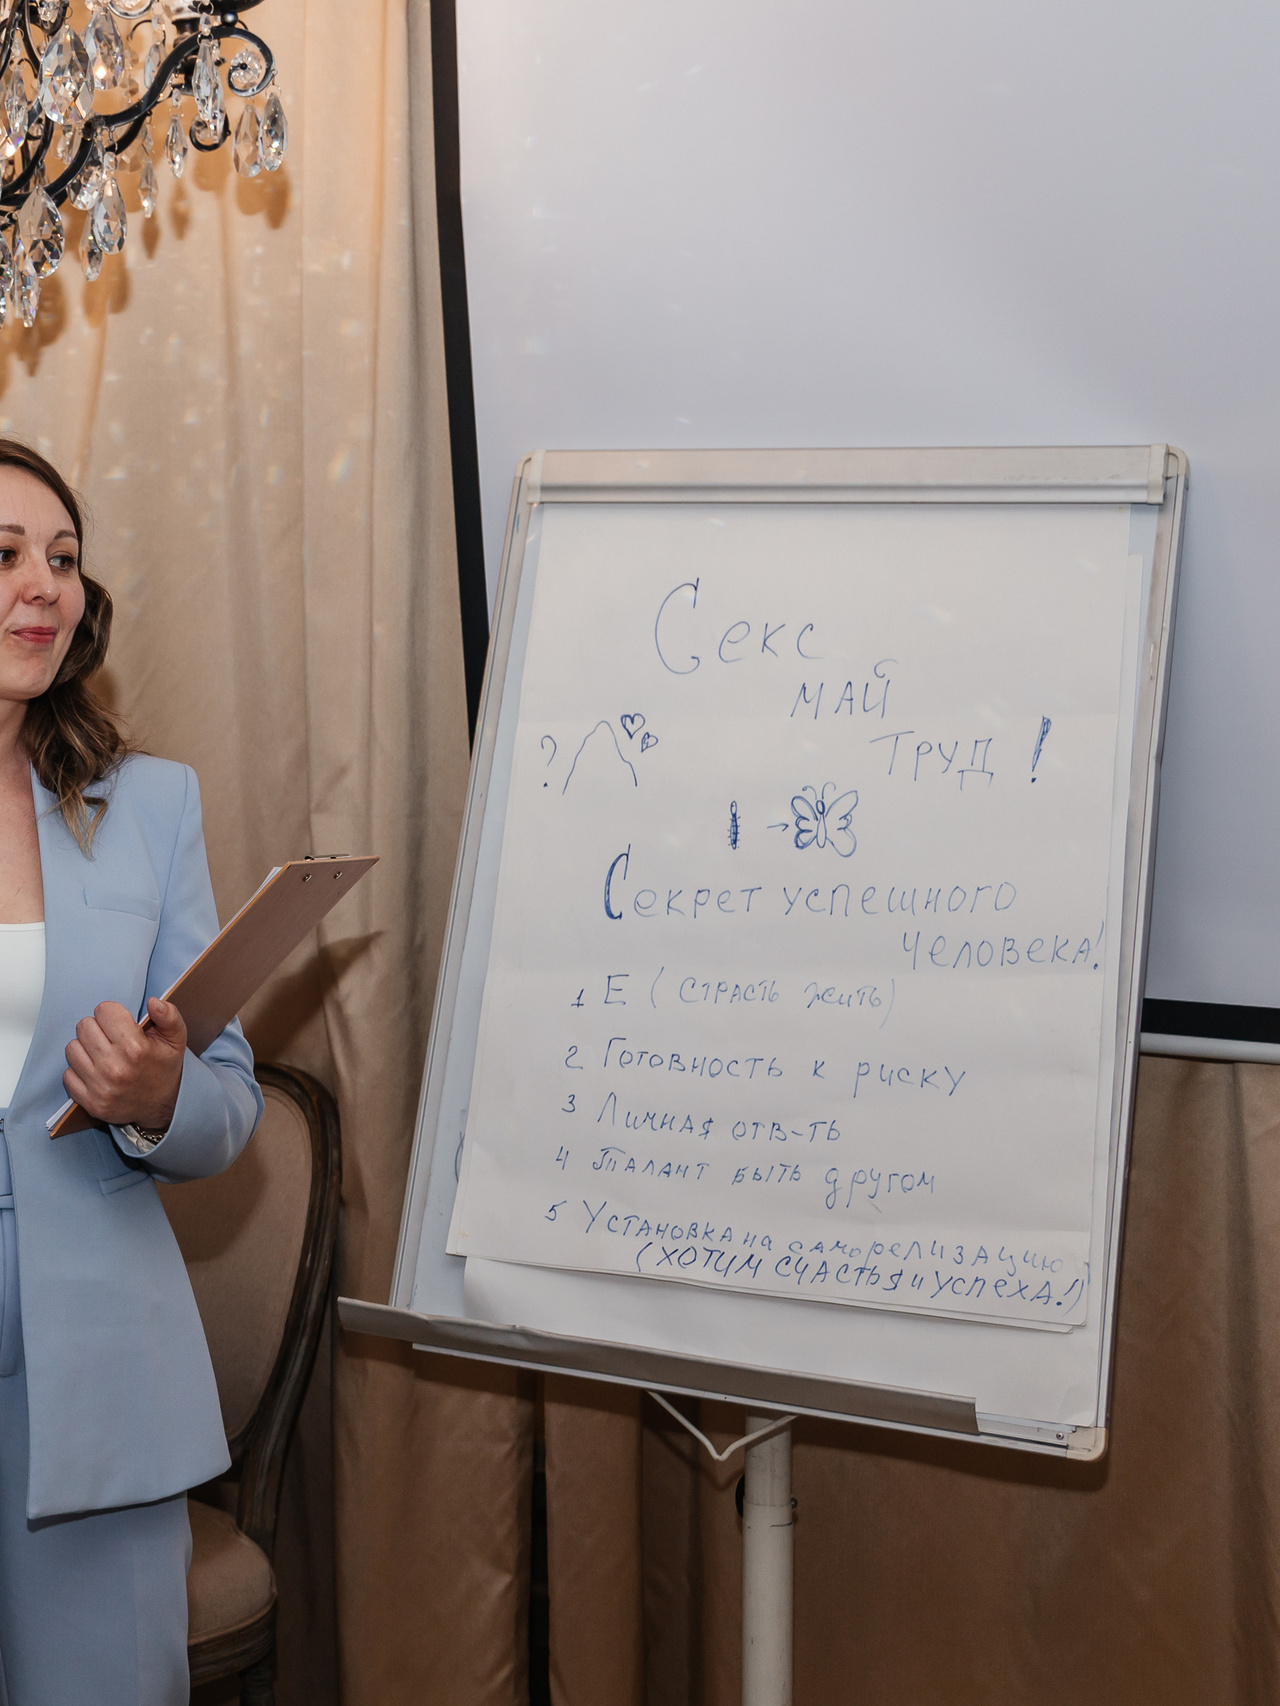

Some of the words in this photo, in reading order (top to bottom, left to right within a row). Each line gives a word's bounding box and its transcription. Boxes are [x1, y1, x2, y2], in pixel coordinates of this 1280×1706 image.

[655, 577, 824, 675] Секс
[604, 844, 762, 920] Секрет
[783, 881, 1018, 917] успешного
[571, 989, 585, 1008] 1
[565, 1045, 584, 1070] 2
[604, 1037, 783, 1080] Готовность
[853, 1061, 966, 1099] риску
[561, 1093, 576, 1113] 3
[555, 1146, 569, 1171] 4
[545, 1200, 568, 1222] 5
